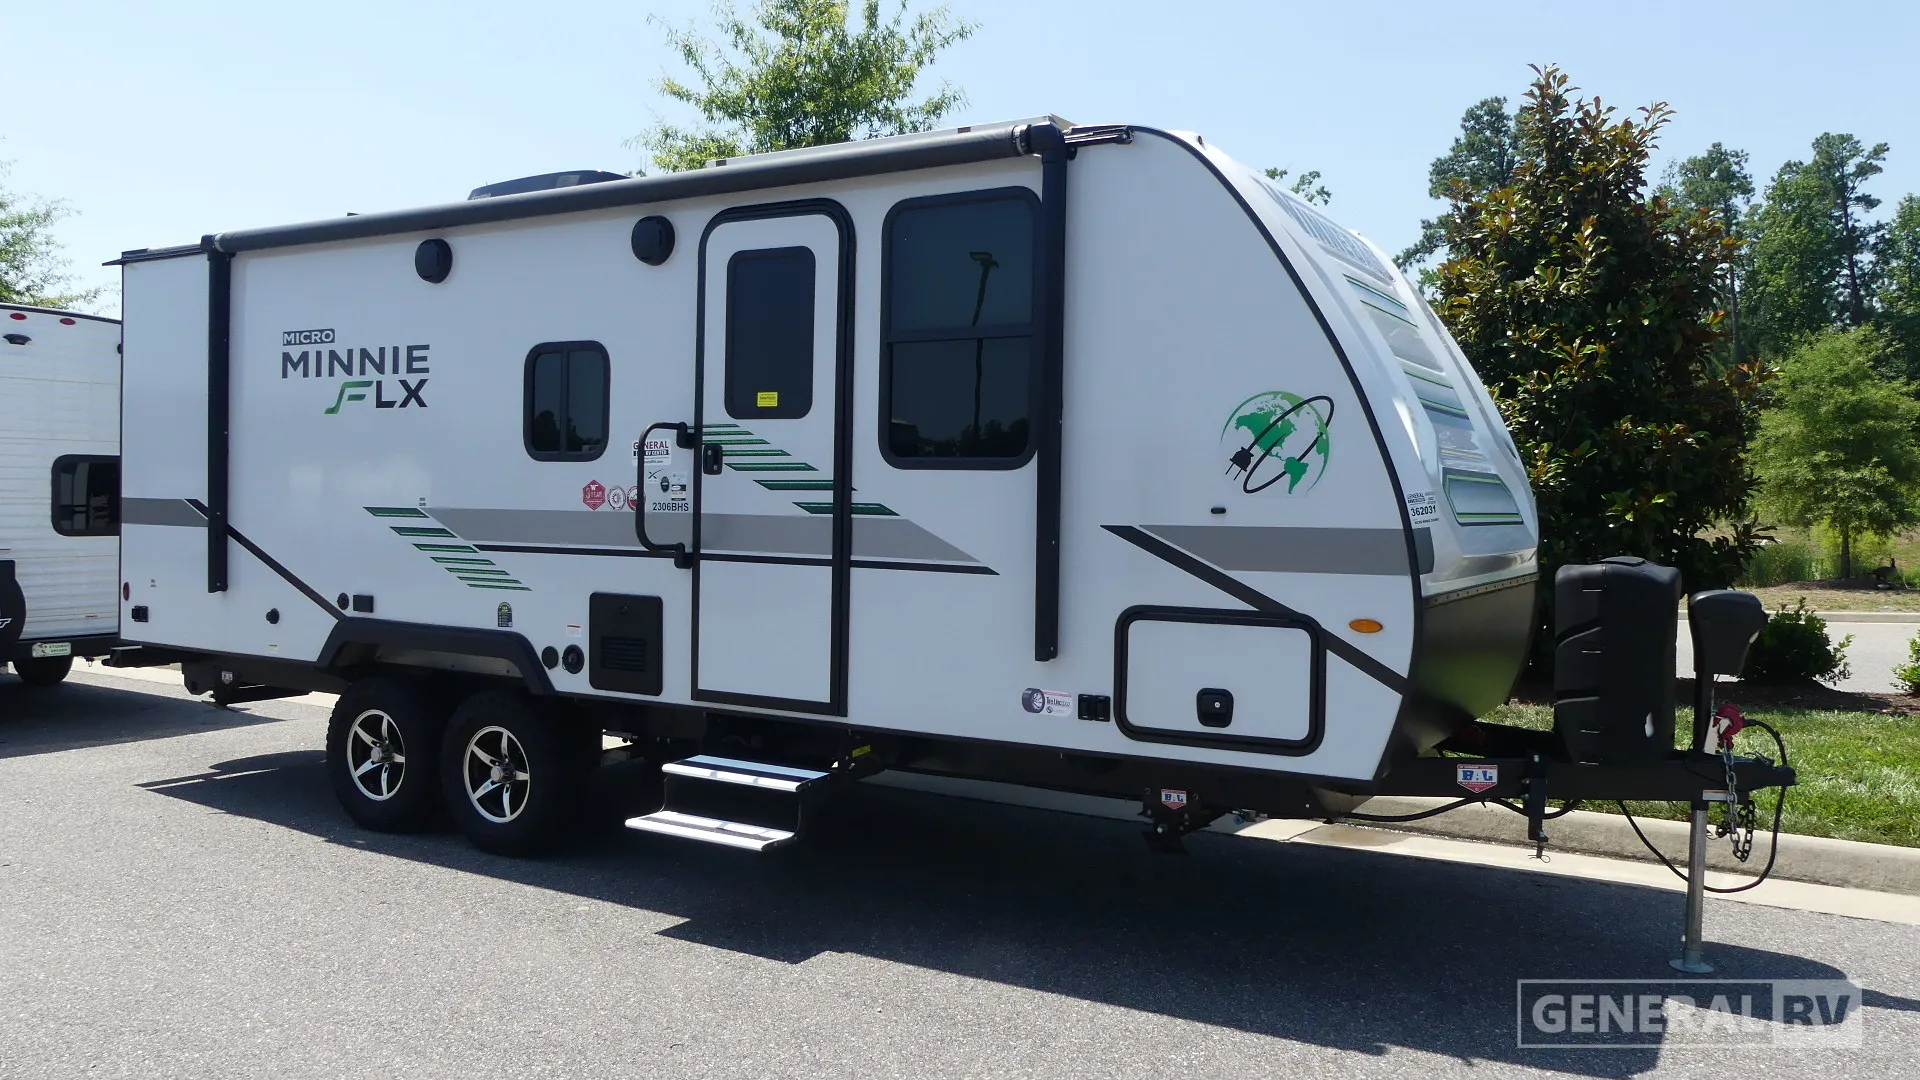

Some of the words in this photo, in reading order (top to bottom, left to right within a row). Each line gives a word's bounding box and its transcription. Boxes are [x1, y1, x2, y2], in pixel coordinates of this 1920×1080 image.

[283, 330, 334, 345] MICRO
[282, 344, 430, 379] MINNIE
[324, 378, 429, 414] FLX
[633, 440, 669, 450] GNERAL
[652, 502, 689, 511] 2306BHS
[1410, 505, 1436, 516] 362031
